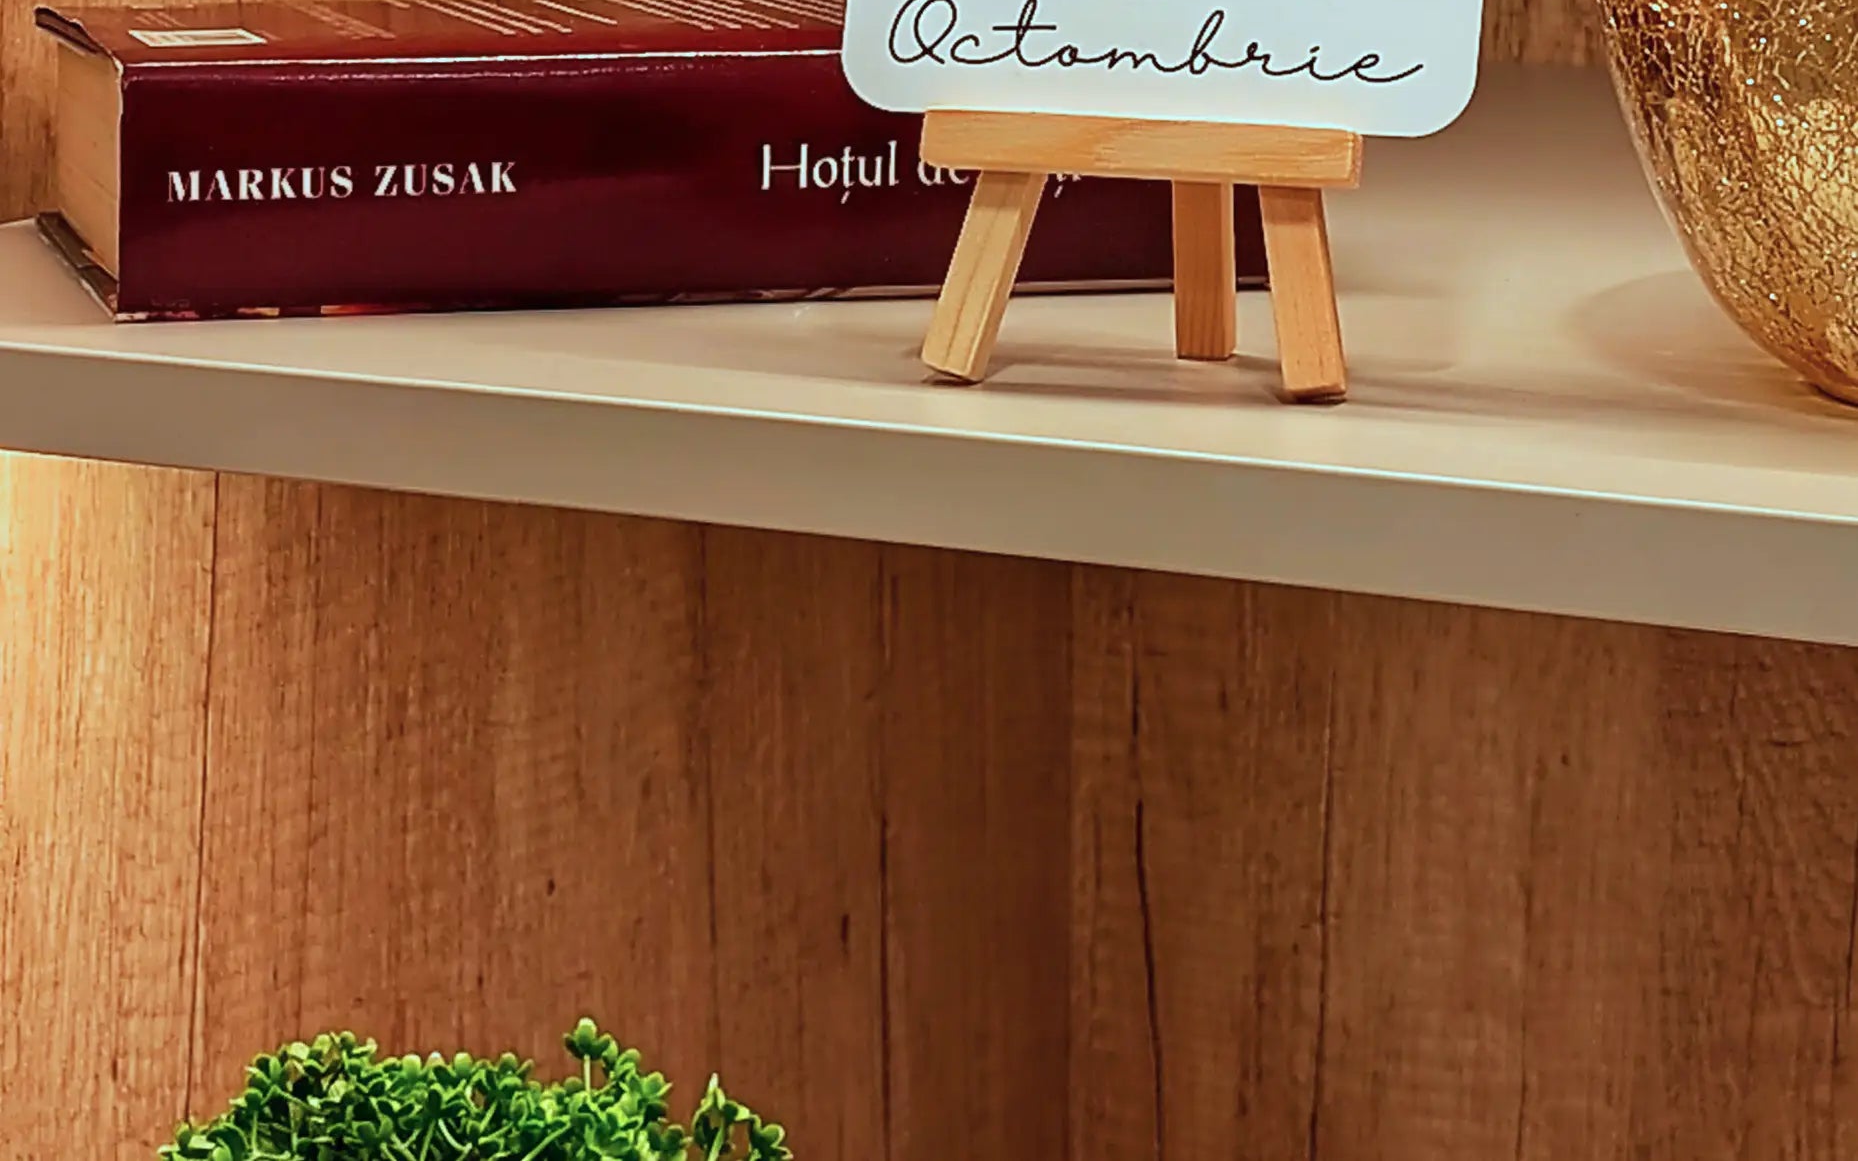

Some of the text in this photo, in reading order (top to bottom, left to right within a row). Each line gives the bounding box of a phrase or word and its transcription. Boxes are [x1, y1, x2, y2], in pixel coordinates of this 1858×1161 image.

[166, 161, 517, 203] MARKUS ZUSAK
[761, 140, 899, 205] Hoțul
